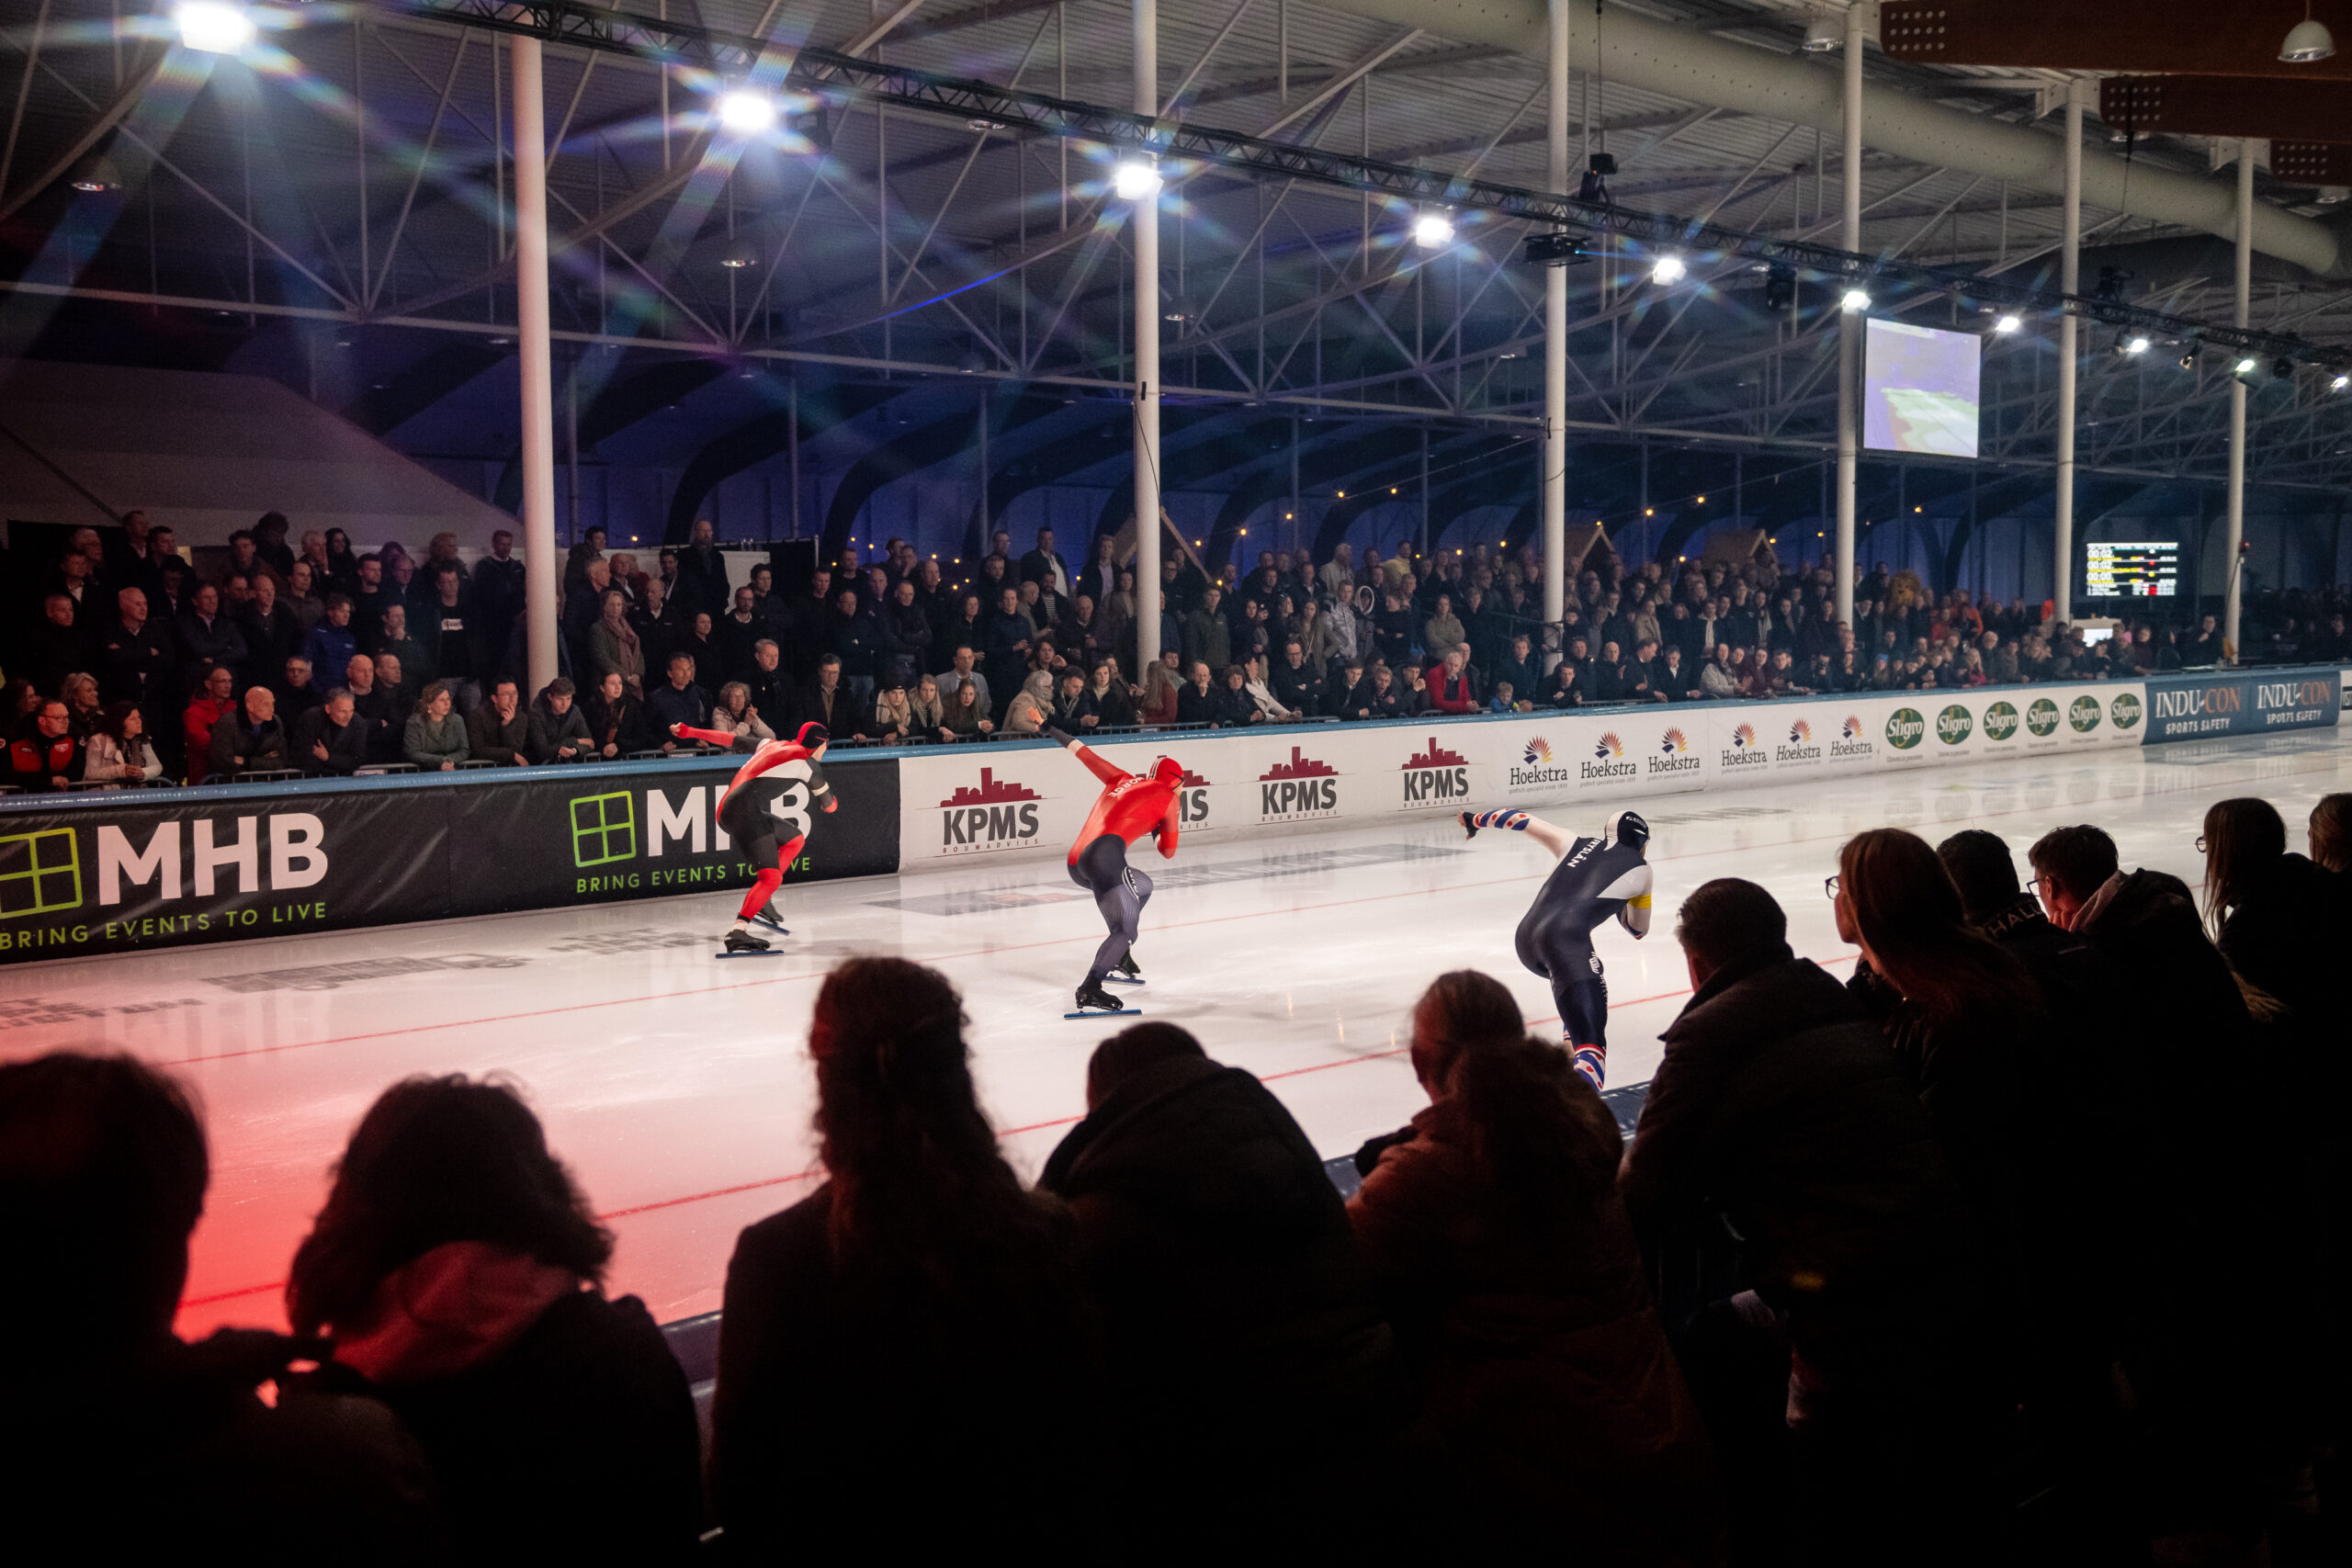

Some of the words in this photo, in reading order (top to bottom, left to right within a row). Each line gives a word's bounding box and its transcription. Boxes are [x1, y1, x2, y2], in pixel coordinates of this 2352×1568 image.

[2154, 687, 2241, 718] INDU-CON
[2256, 681, 2331, 709] INDU-CON
[1984, 711, 2018, 732] Sligro
[2027, 708, 2059, 728] Sligro
[2070, 705, 2100, 725] Sligro
[2112, 703, 2141, 721] Sligro
[2267, 713, 2294, 725] SPORTS
[2296, 710, 2322, 721] SAFETY
[1887, 718, 1923, 739] Sligro
[1938, 715, 1972, 736] Sligro
[2165, 720, 2199, 735] SPORTS
[2200, 718, 2231, 731] SAFETY
[1722, 749, 1767, 766] Hoekstra
[1776, 744, 1821, 761] Hoekstra
[1830, 739, 1872, 756] Hoekstra
[1580, 759, 1636, 779] Hoekstra
[1648, 753, 1700, 773] Hoekstra
[1404, 767, 1469, 801] KPMS
[1510, 765, 1567, 785] Hoekstra
[1261, 779, 1337, 815] KPMS
[1404, 797, 1470, 808] BOUWADVIES
[647, 782, 811, 857] MB
[944, 803, 1038, 845] KPMS
[1261, 809, 1338, 821] BOUWADVIES
[943, 838, 1038, 853] BOUWADVIES
[97, 812, 328, 906] MHB
[576, 873, 640, 894] BRING
[651, 865, 726, 886] EVENTS
[0, 925, 88, 950] BRING
[106, 913, 210, 940] EVENTS
[225, 908, 258, 928] TO
[273, 902, 326, 922] LIVE
